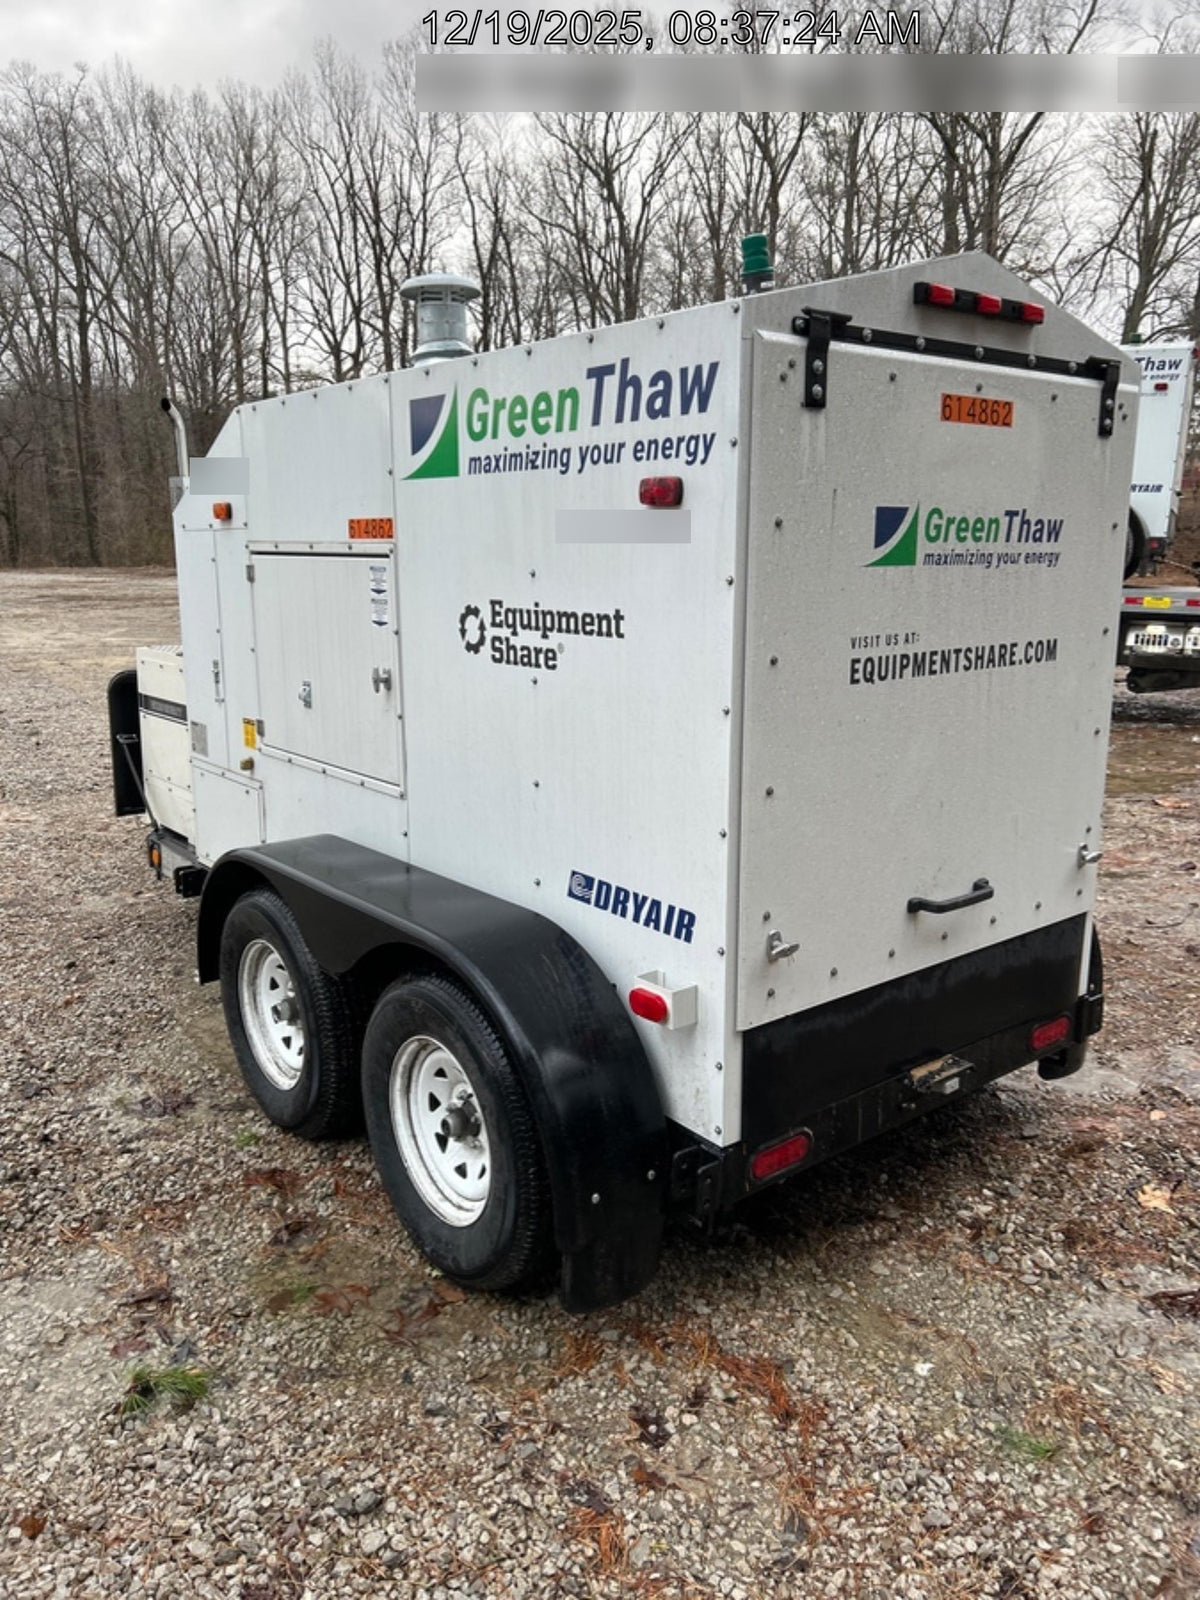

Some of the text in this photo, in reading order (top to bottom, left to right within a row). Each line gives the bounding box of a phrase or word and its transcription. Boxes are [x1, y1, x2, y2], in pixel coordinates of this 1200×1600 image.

[942, 394, 1012, 427] 614862
[468, 432, 717, 475] maximizing your energy
[349, 518, 393, 539] 614862
[923, 549, 1061, 569] maximizing your energy
[490, 599, 625, 640] Equipment
[851, 632, 920, 649] VISIT US AT:
[849, 638, 1058, 685] EQUIPMENTSHARE.COM
[593, 879, 697, 944] DRYAIR
